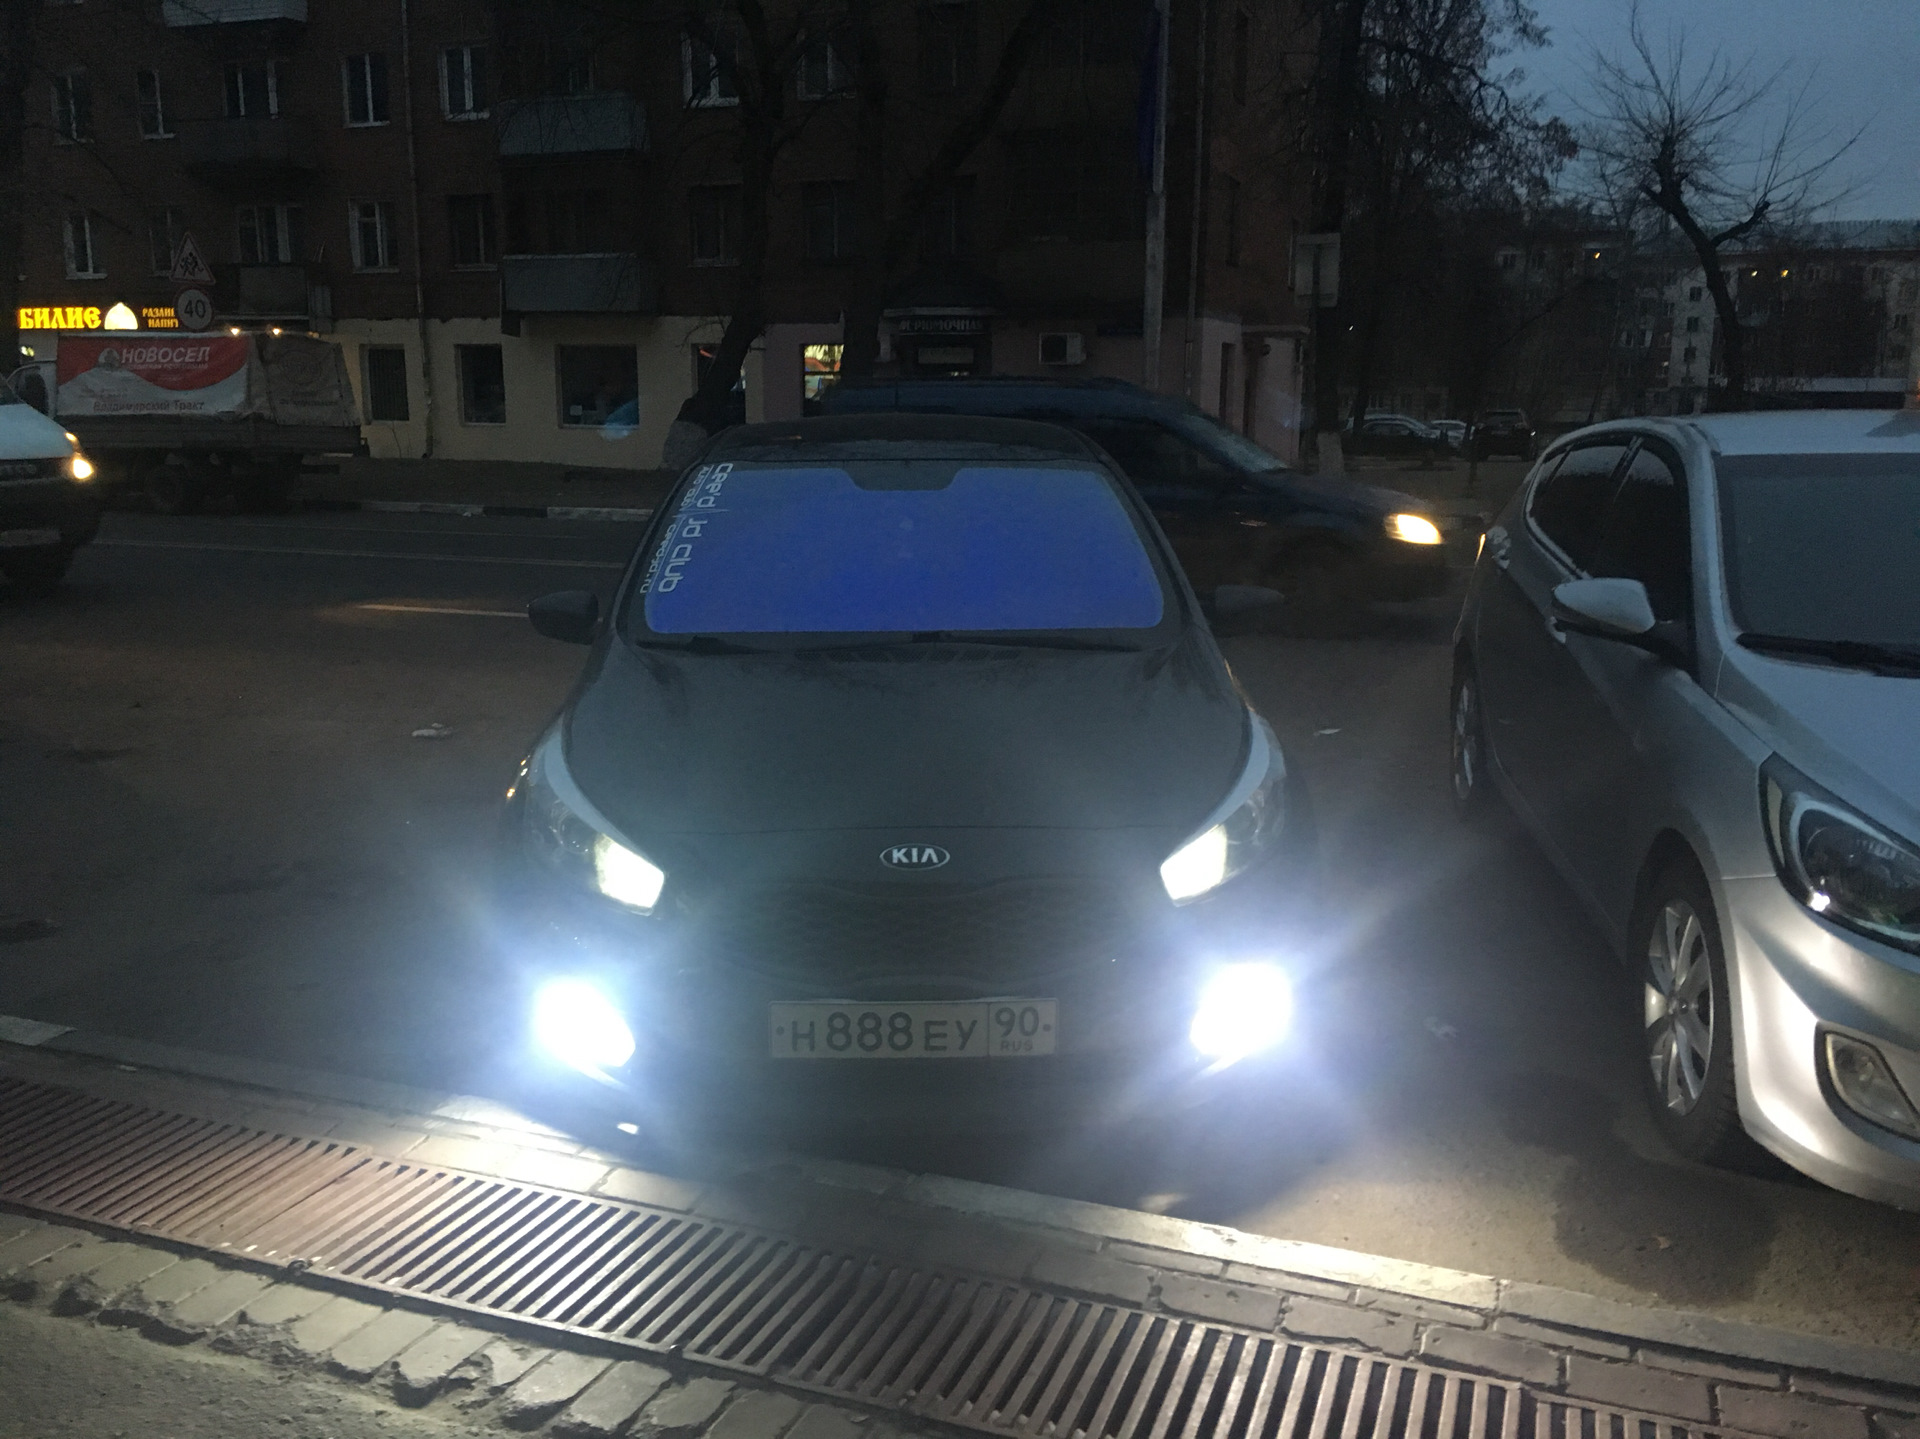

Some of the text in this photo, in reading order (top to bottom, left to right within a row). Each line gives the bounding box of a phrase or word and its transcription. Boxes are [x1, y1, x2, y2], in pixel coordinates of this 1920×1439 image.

[183, 296, 207, 319] 40
[121, 346, 211, 364] НОВОСЕЛ
[658, 544, 692, 593] club
[891, 847, 939, 864] KIA
[995, 1006, 1040, 1037] 90
[1000, 1040, 1034, 1052] RUS
